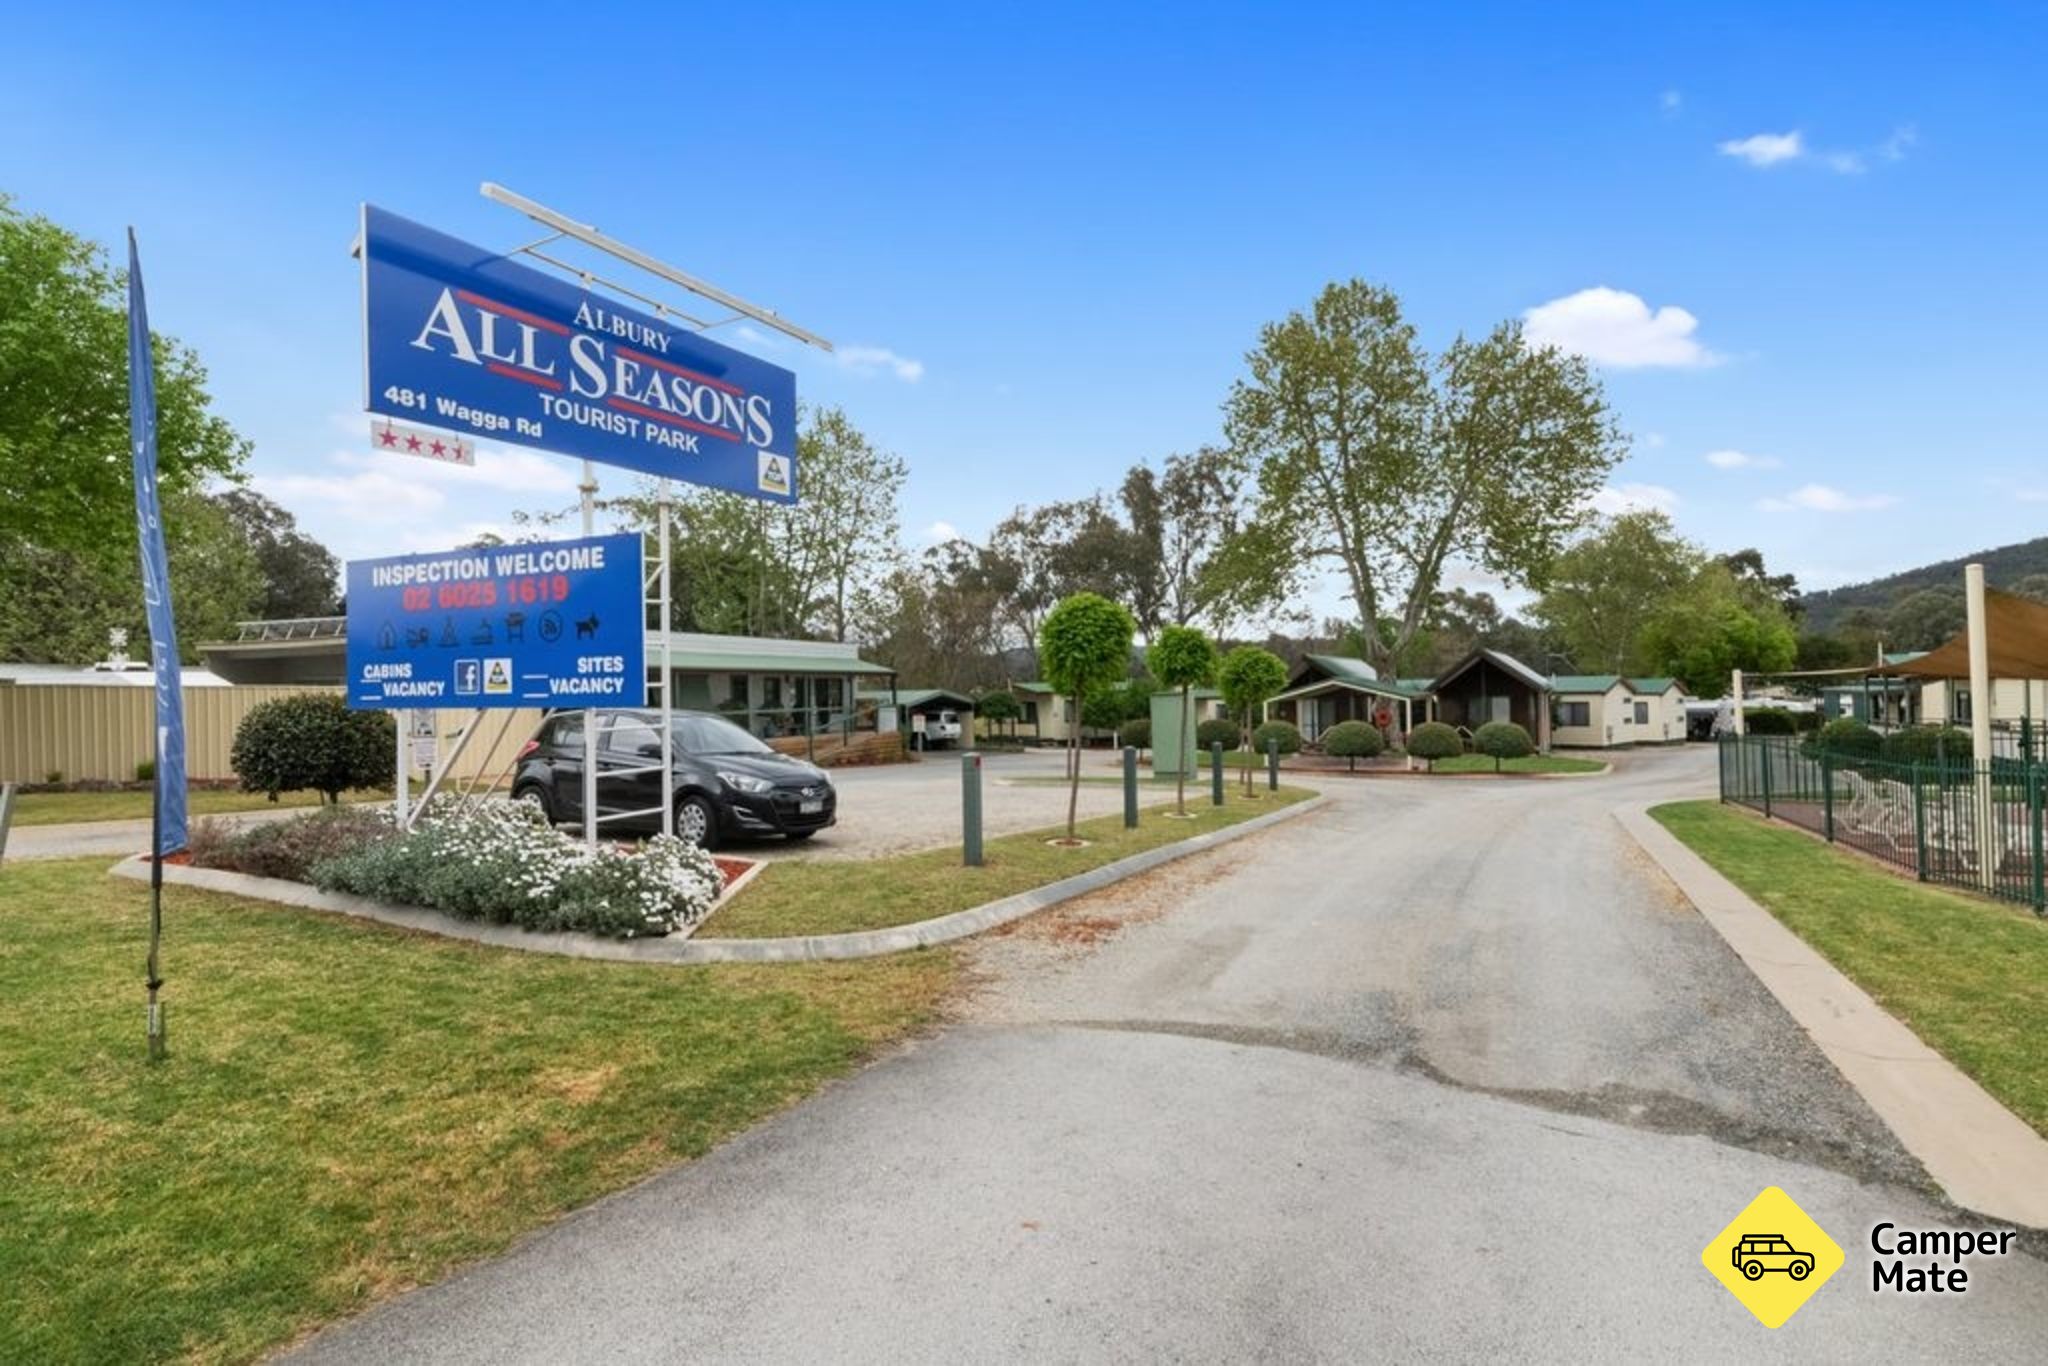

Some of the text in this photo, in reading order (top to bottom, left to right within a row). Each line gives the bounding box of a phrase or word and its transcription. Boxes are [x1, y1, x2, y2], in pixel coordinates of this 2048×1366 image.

[573, 301, 671, 354] ALBURY
[410, 287, 774, 448] ALL SEASONS
[383, 385, 543, 439] 481 Wagga Rd
[539, 392, 699, 454] TOURIST PARK
[372, 546, 605, 587] INSPECTION WELCOME
[403, 587, 431, 611] 02
[506, 574, 569, 604] 1619
[363, 663, 412, 679] CABINS
[577, 656, 624, 674] SITES
[382, 681, 445, 698] VACANCY
[549, 678, 625, 696] VACANCY
